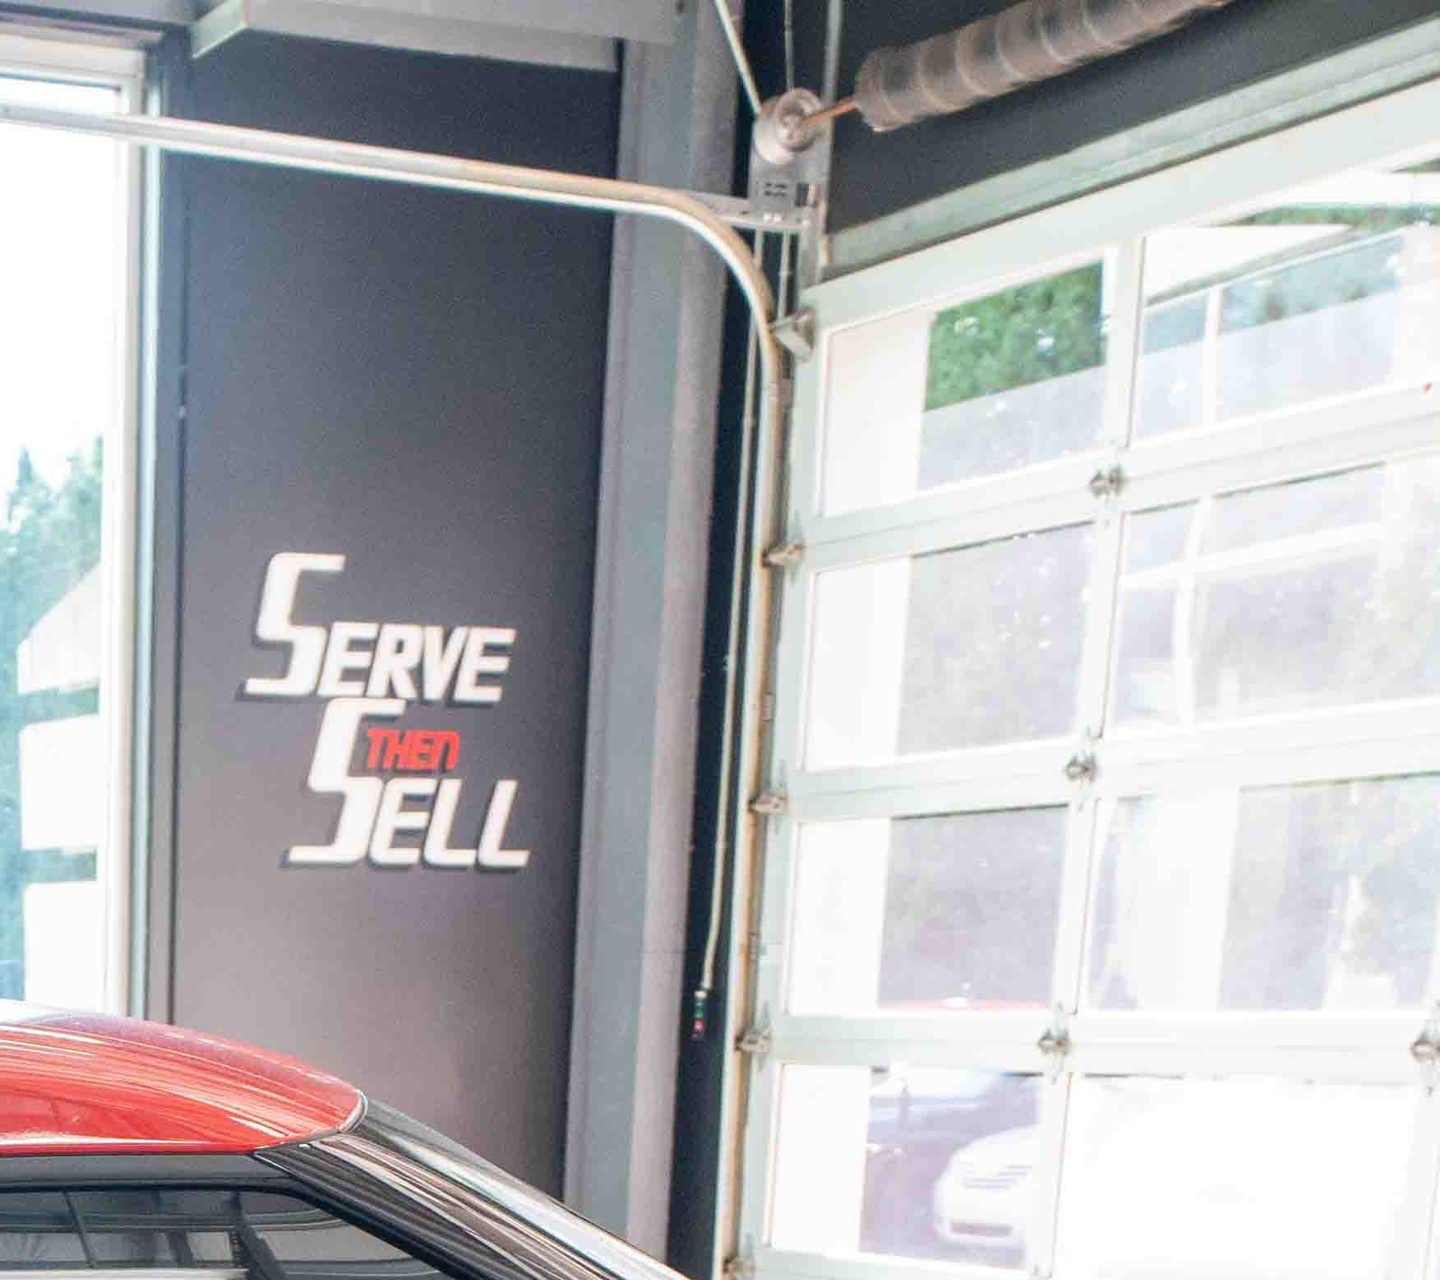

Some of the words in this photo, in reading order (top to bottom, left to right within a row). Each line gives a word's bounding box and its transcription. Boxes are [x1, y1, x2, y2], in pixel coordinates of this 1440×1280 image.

[245, 552, 518, 703] SERVE
[287, 697, 530, 868] SELL
[367, 728, 460, 771] THEN
